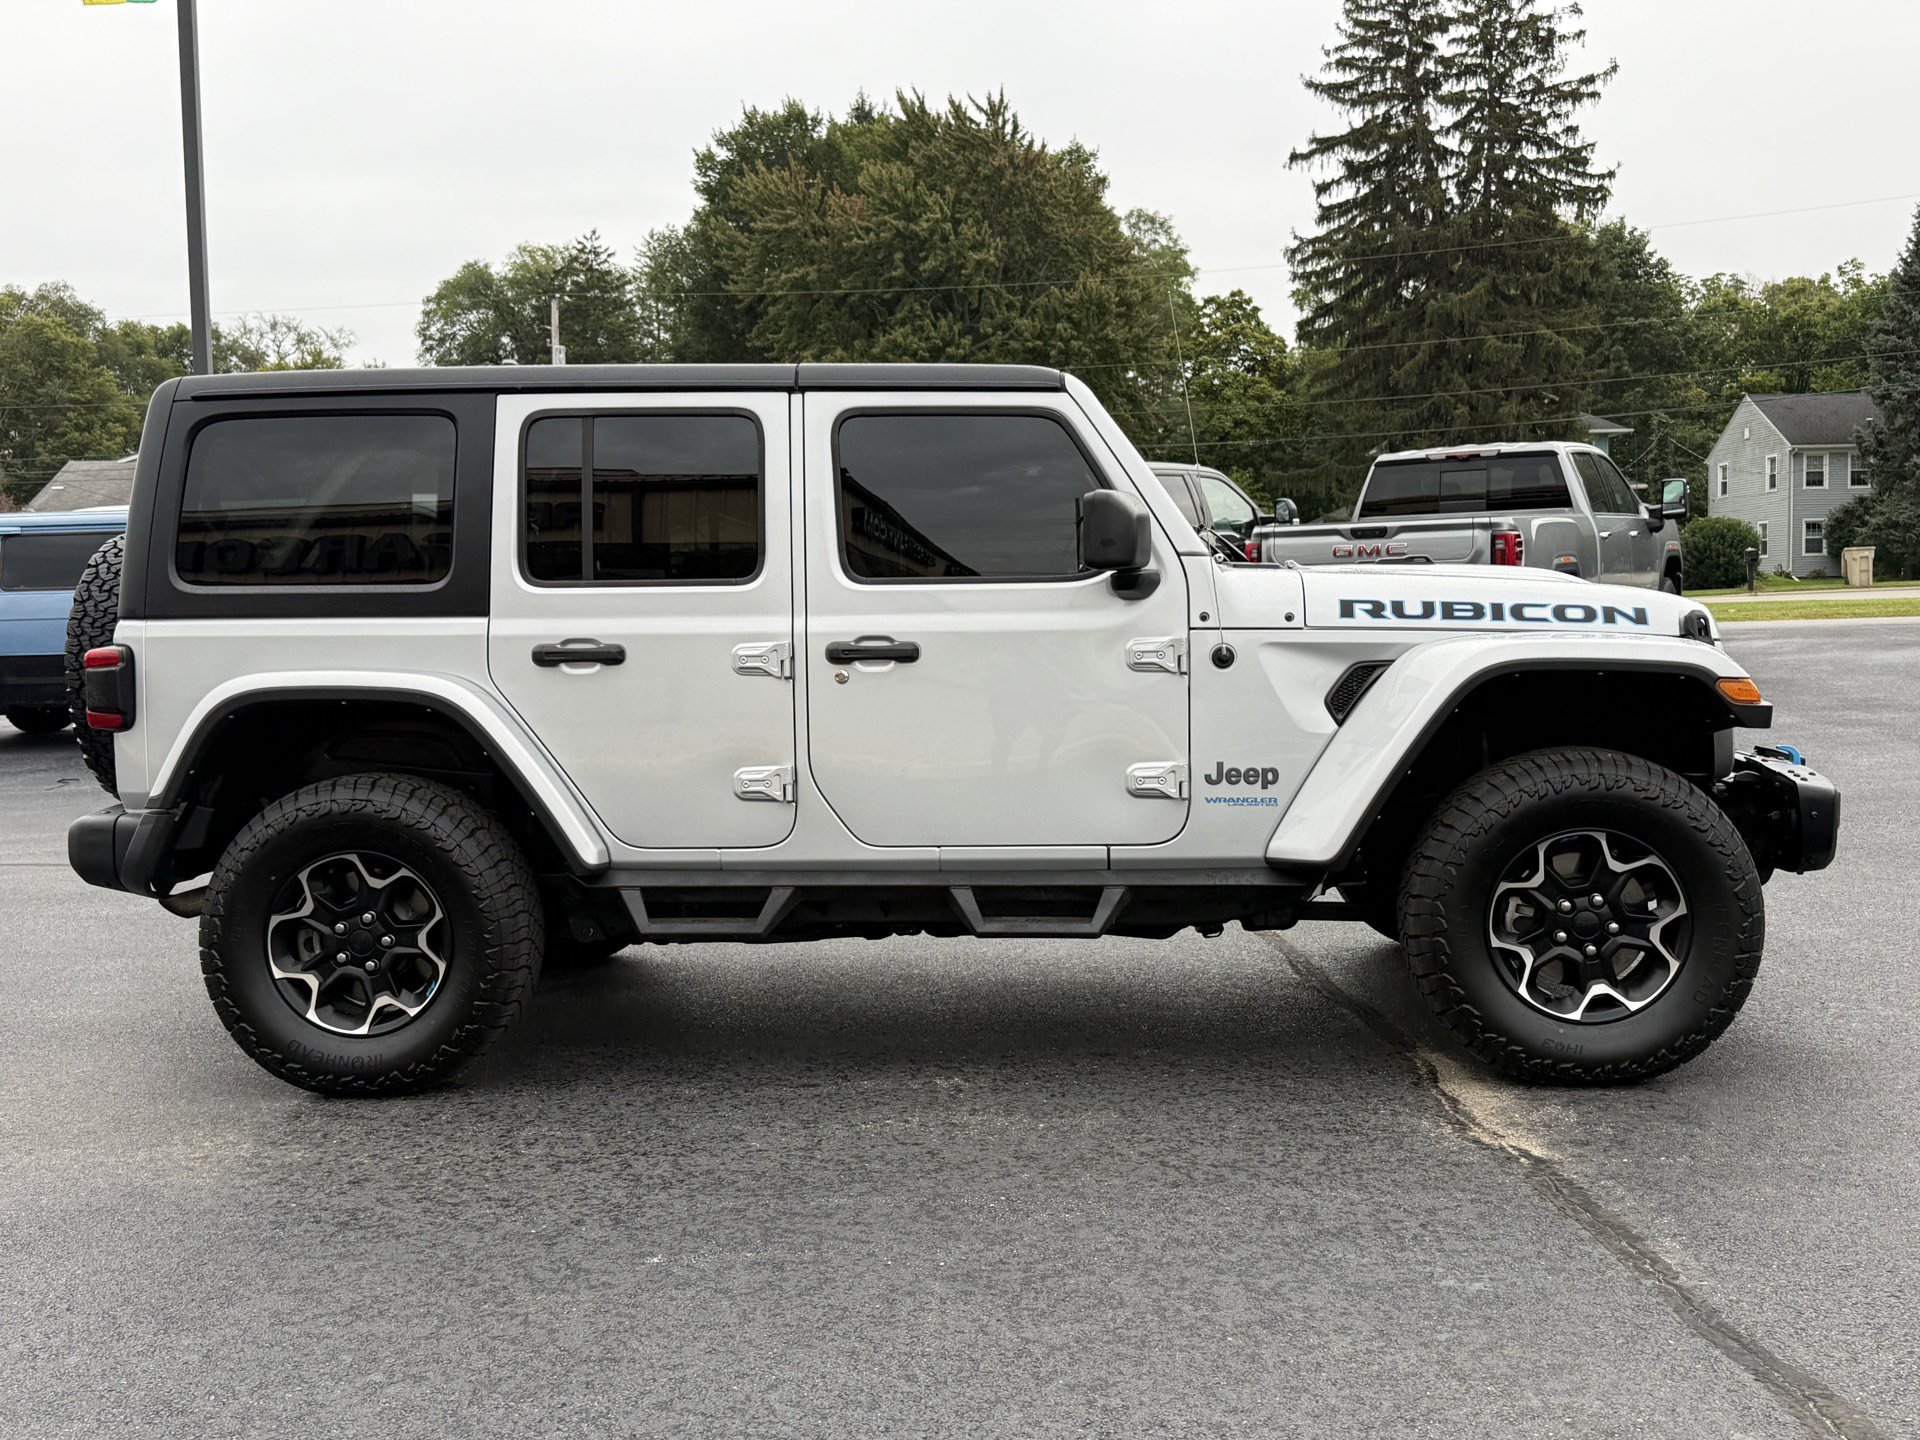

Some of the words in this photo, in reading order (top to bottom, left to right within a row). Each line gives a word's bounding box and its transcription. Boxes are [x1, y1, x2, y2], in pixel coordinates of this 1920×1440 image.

[1332, 542, 1407, 558] GMC
[1339, 599, 1649, 625] RUBICON
[1204, 761, 1279, 789] Jeep
[287, 1039, 384, 1070] IRONHEAD
